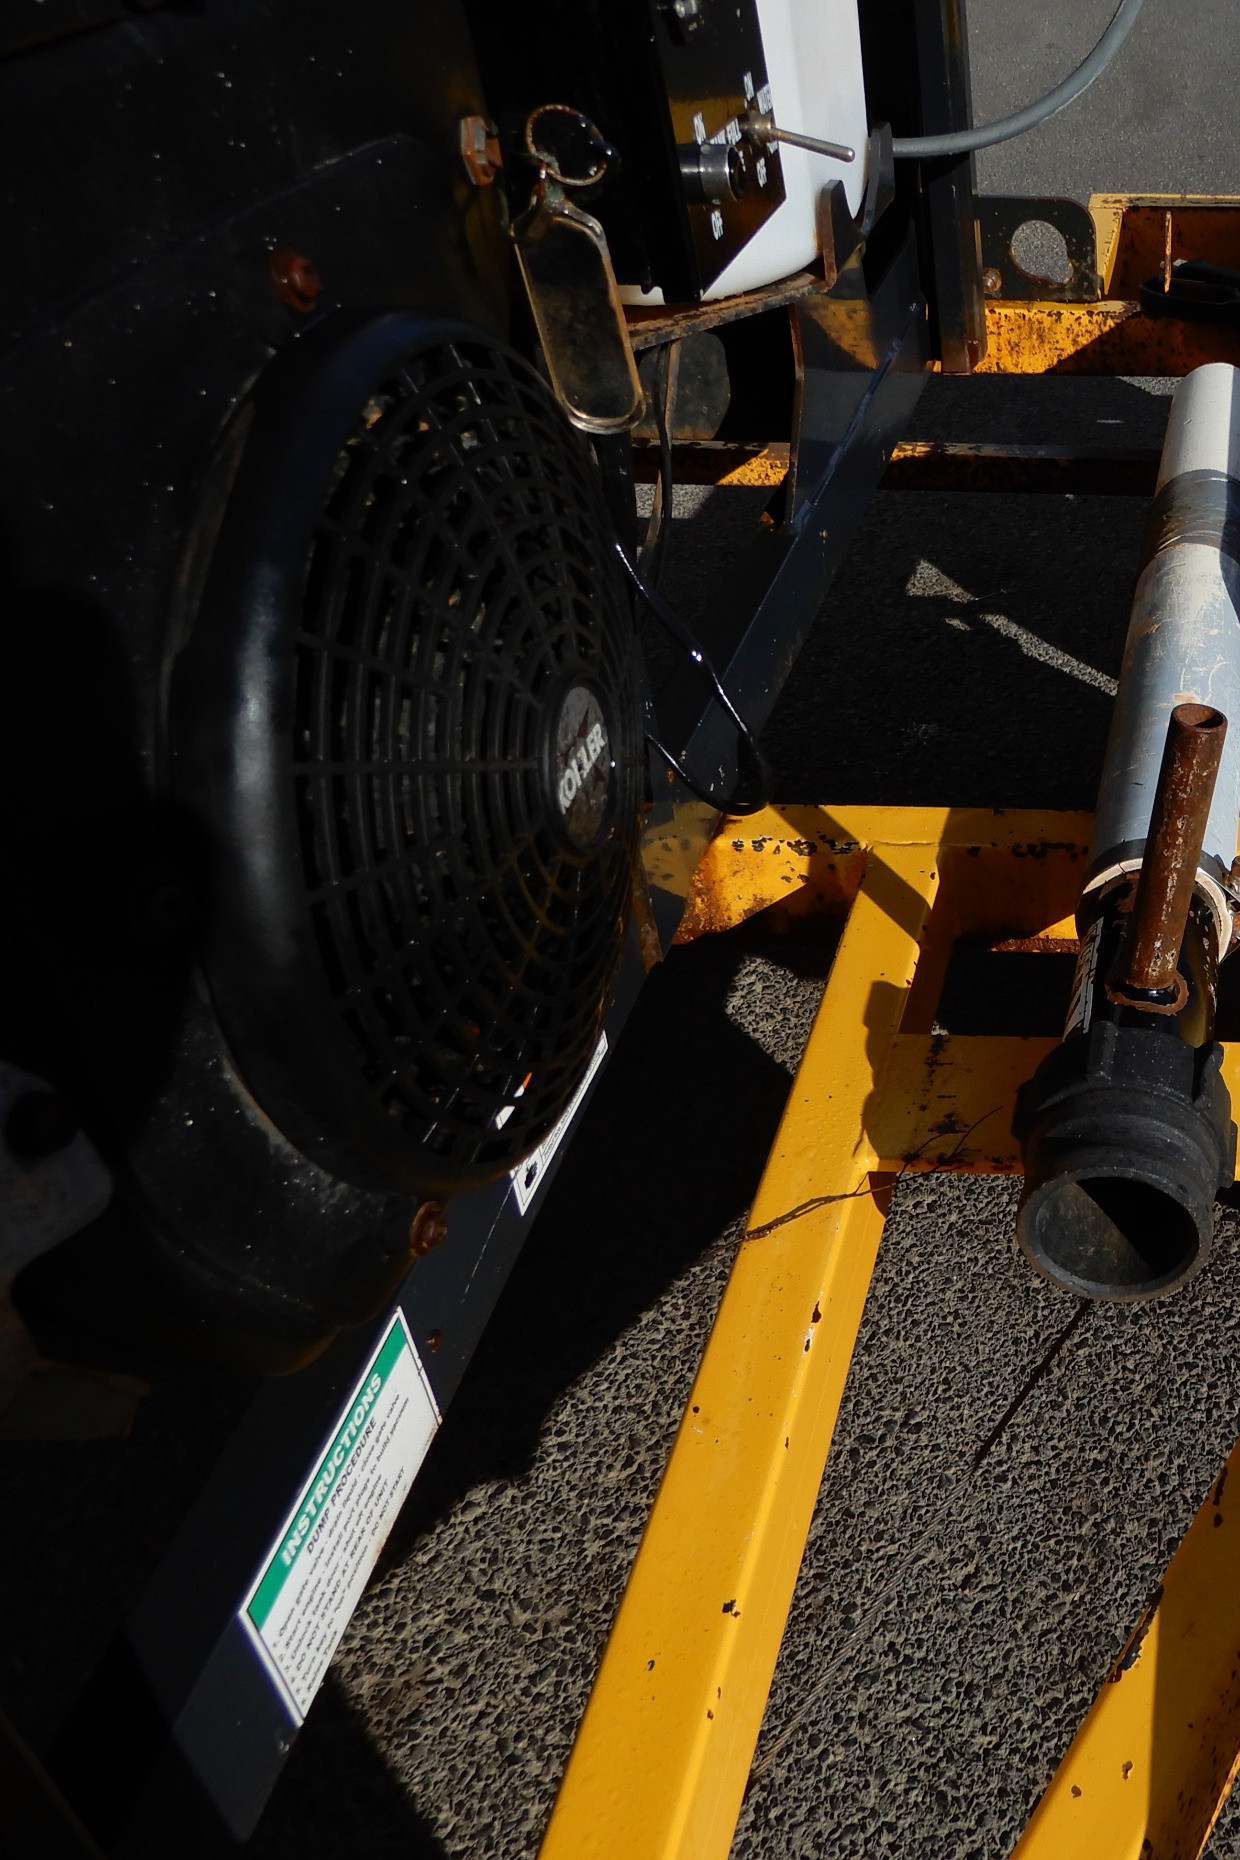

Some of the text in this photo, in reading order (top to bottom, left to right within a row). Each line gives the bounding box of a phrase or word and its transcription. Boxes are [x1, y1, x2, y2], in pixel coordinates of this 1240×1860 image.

[693, 111, 706, 146] ON
[743, 71, 755, 102] ON
[711, 209, 724, 241] OFF
[756, 157, 767, 188] OFF
[278, 1607, 295, 1637] Open
[294, 1578, 309, 1605] gate
[308, 1546, 324, 1575] valve
[327, 1510, 342, 1538] drain
[341, 1477, 357, 1508] liquid
[360, 1444, 375, 1472] close
[374, 1420, 386, 1444] gate
[385, 1393, 399, 1418] valve
[281, 1373, 382, 1566] INSTRUCTIONS
[284, 1618, 301, 1649] Start
[301, 1577, 321, 1616] engine
[324, 1531, 343, 1567] install
[342, 1506, 355, 1532] port
[354, 1477, 370, 1507] plugs
[375, 1435, 390, 1462] build
[389, 1397, 408, 1435] vacuum
[306, 1417, 375, 1554] DUMP PROCEDURE
[290, 1619, 312, 1660] Unlock
[311, 1590, 326, 1615] tank
[325, 1561, 339, 1587] door
[342, 1527, 355, 1552] shut
[355, 1509, 363, 1526] off
[363, 1473, 382, 1509] engine
[295, 1651, 306, 1671] DO
[305, 1622, 319, 1649] NOT
[320, 1578, 340, 1619] STAND
[341, 1560, 349, 1577] AT
[349, 1526, 365, 1558] REAR
[365, 1508, 373, 1525] OF
[373, 1479, 388, 1507] UNIT
[301, 1655, 316, 1681] Turn
[315, 1631, 327, 1652] key
[346, 1544, 368, 1589] position
[370, 1520, 379, 1536] DO
[378, 1498, 389, 1520] NOT
[389, 1467, 404, 1498] START
[306, 1659, 323, 1692] Raise
[322, 1629, 338, 1655] Tank
